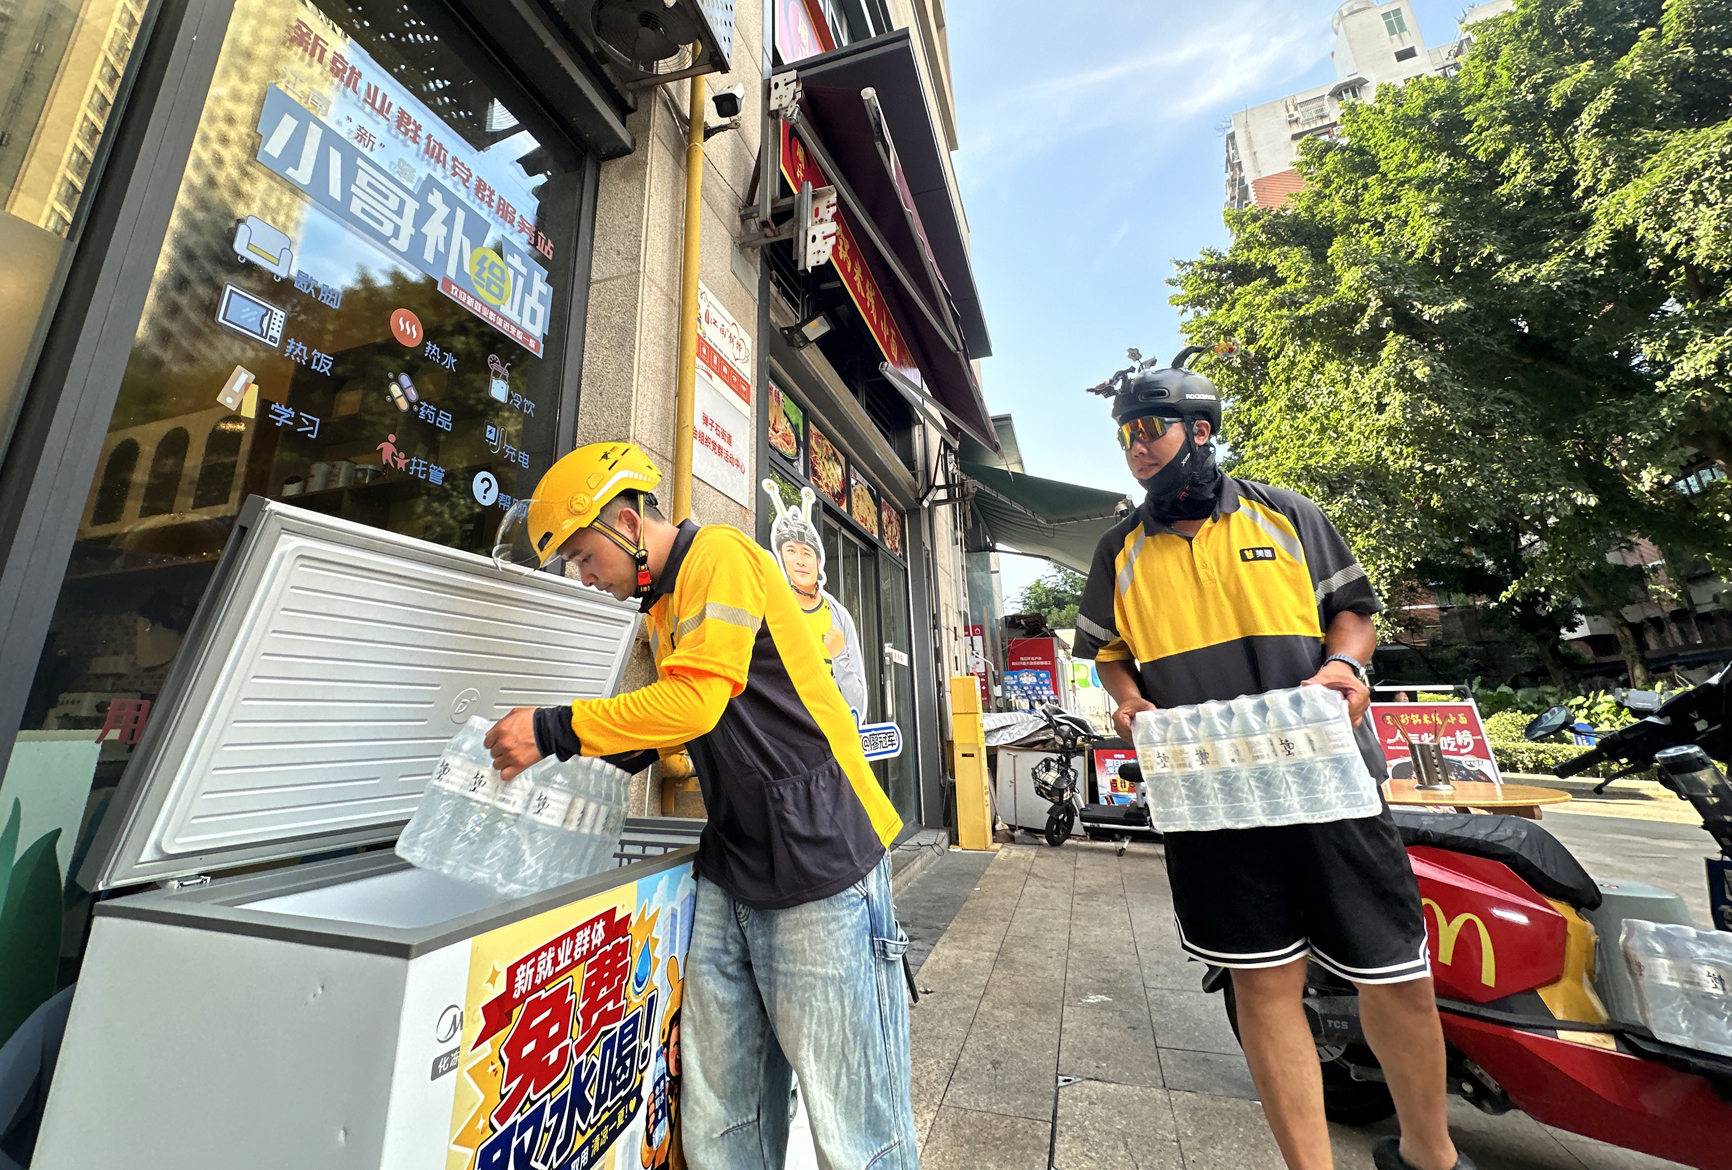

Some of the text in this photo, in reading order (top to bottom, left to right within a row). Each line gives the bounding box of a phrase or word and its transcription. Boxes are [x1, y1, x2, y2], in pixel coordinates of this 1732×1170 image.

[288, 18, 553, 260] 新就业群体党群服务站
[264, 112, 547, 337] 小哥补给站
[295, 269, 343, 309] 歇脚
[284, 338, 334, 377] 热饭
[425, 341, 458, 372] 热水
[268, 402, 321, 439] 学习
[418, 401, 453, 431] 药品
[509, 390, 536, 417] 冷饮
[410, 456, 446, 485] 托管
[504, 445, 531, 469] 充电
[512, 918, 606, 999] 新就业群体
[491, 936, 632, 1128] 免费
[1327, 1019, 1349, 1030] TCS
